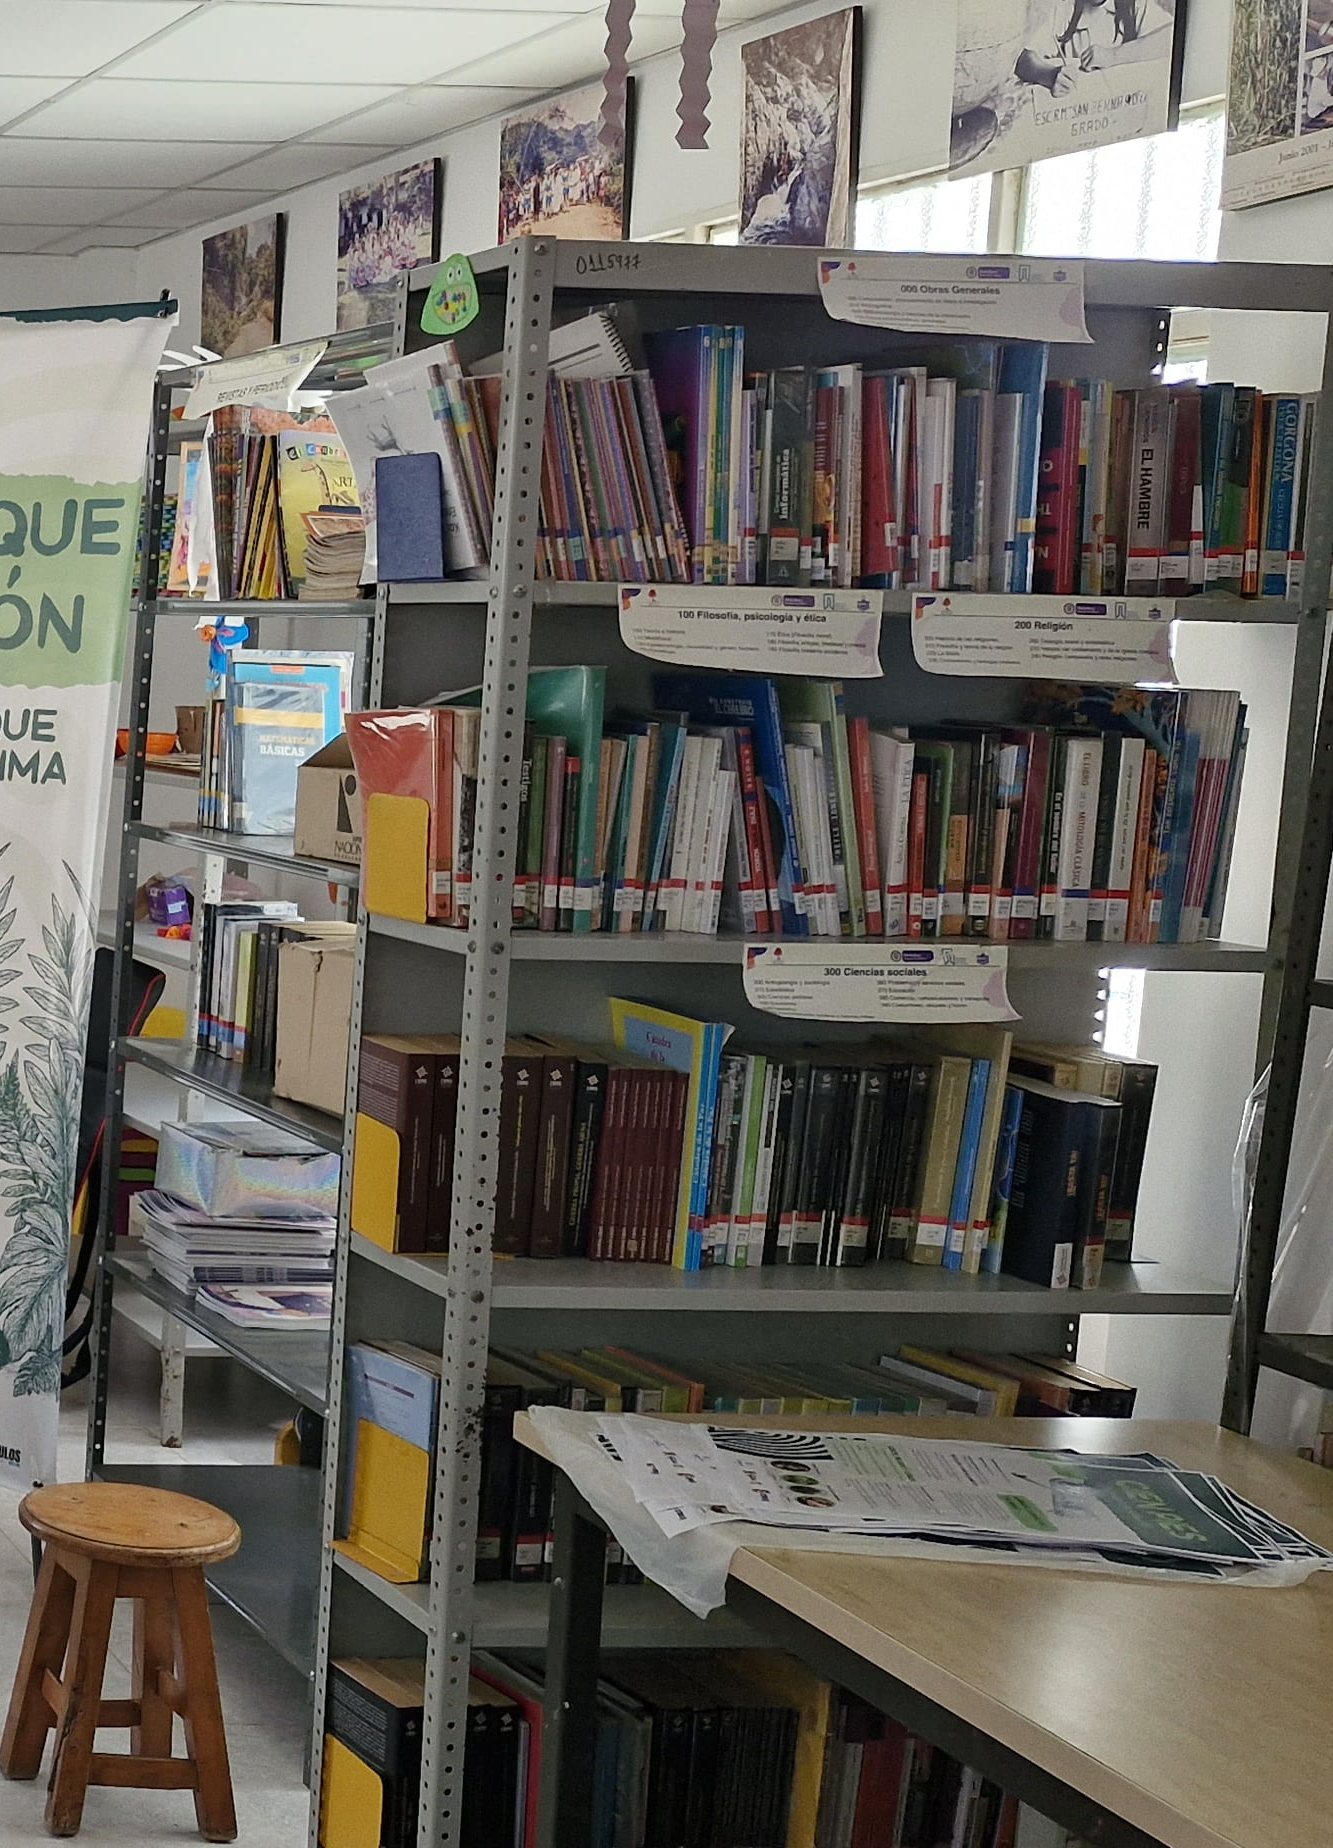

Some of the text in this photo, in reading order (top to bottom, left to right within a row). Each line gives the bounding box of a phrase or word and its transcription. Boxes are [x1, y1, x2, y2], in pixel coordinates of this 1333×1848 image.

[920, 285, 950, 295] Obras
[952, 285, 1001, 296] Generales
[1282, 402, 1299, 483] GORGONA
[1137, 448, 1154, 530] EL HAMBRE
[678, 611, 694, 620] 100
[744, 613, 793, 623] psicología
[804, 613, 827, 623] ética
[1015, 621, 1073, 632] 200 Religión
[824, 967, 928, 977] 300 Ciencias sociales
